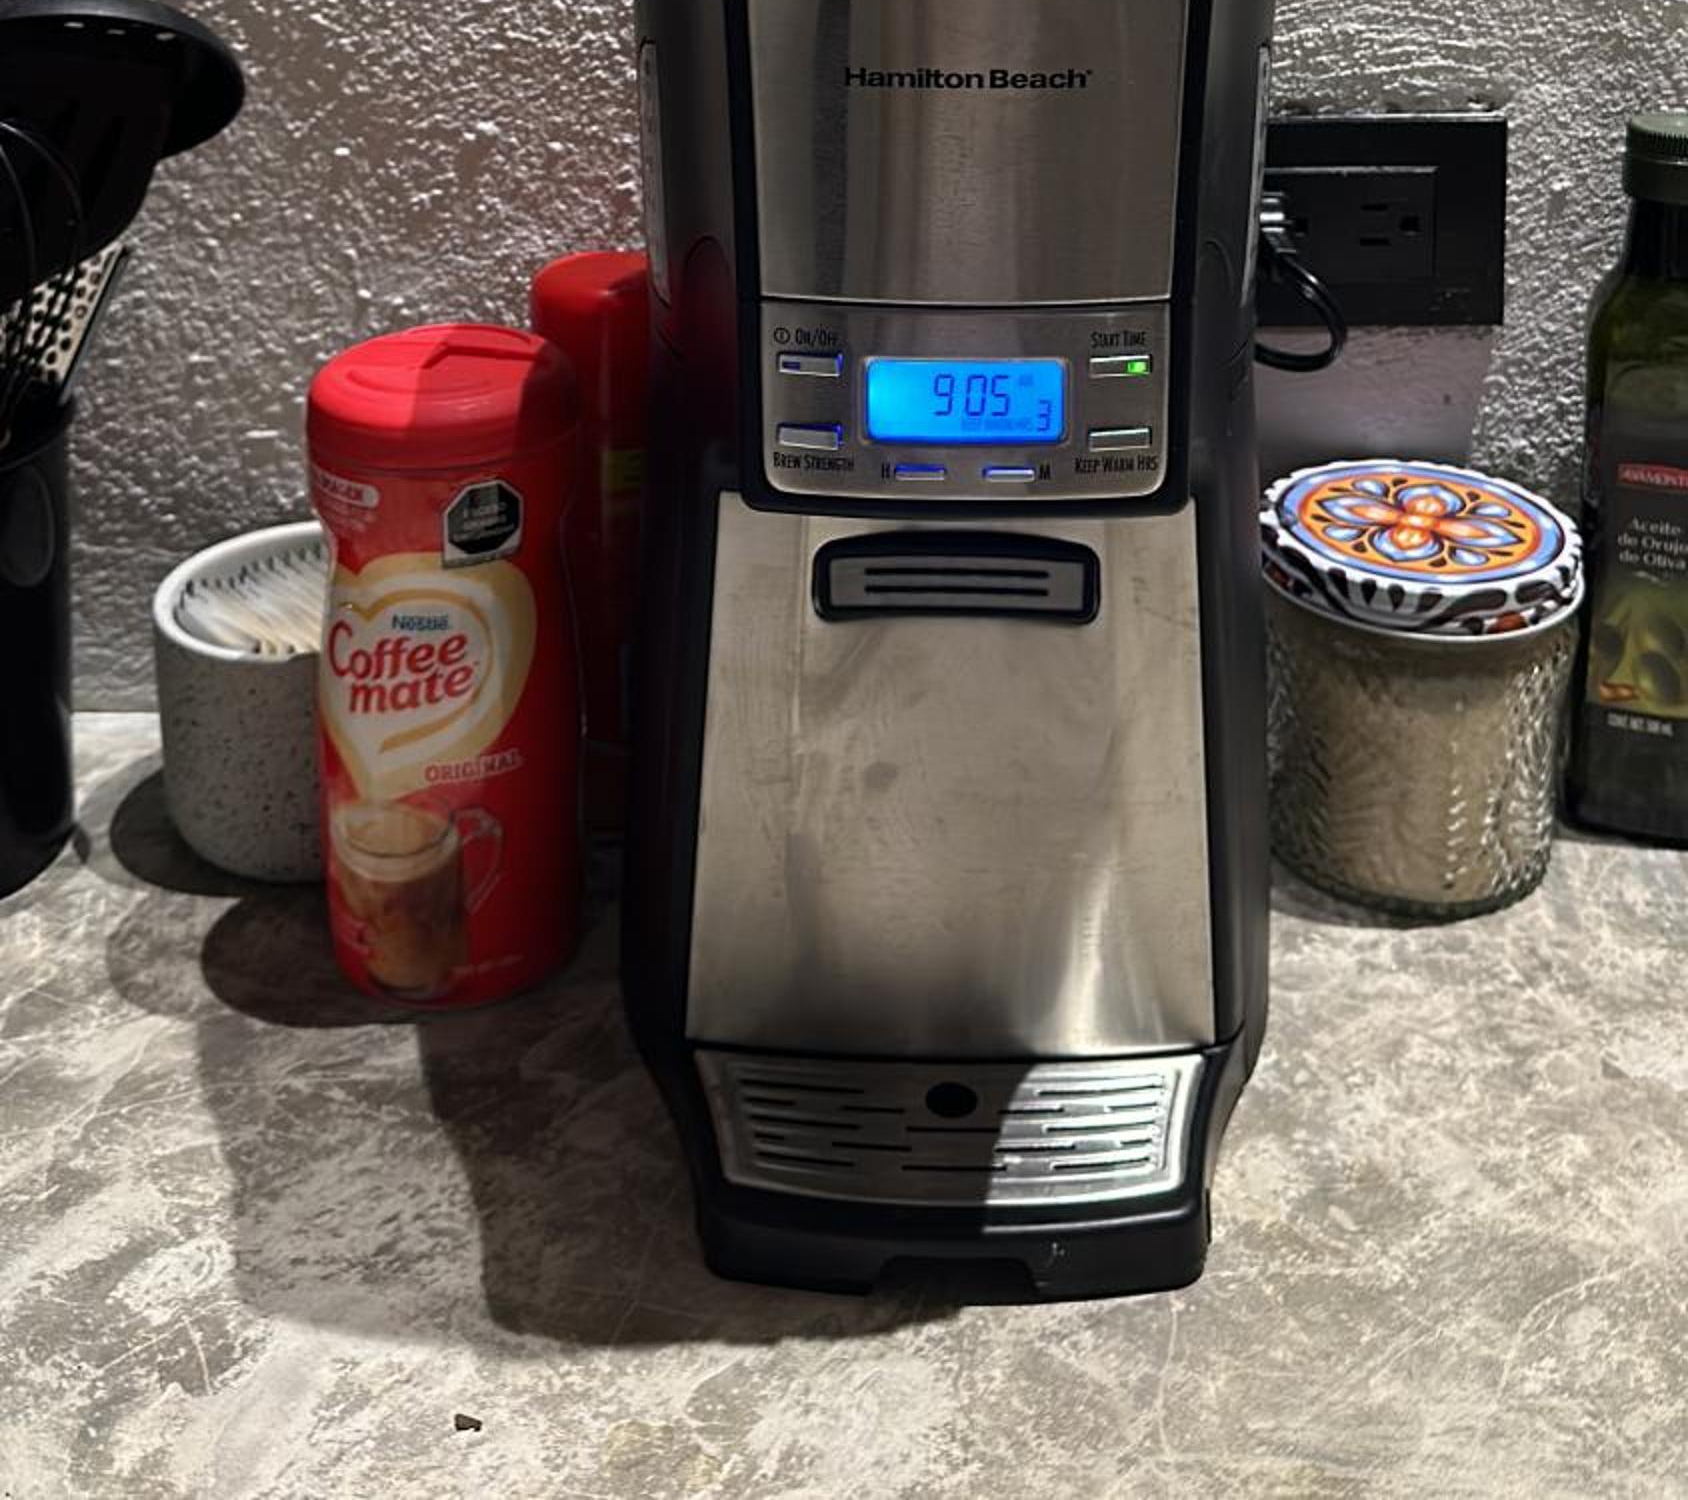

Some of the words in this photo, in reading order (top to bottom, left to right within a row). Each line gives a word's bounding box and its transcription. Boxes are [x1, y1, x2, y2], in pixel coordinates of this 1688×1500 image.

[844, 66, 984, 89] Hamilton
[989, 68, 1088, 90] Beach
[1037, 398, 1053, 432] 3
[327, 618, 469, 681] Coffee
[349, 664, 475, 714] mate
